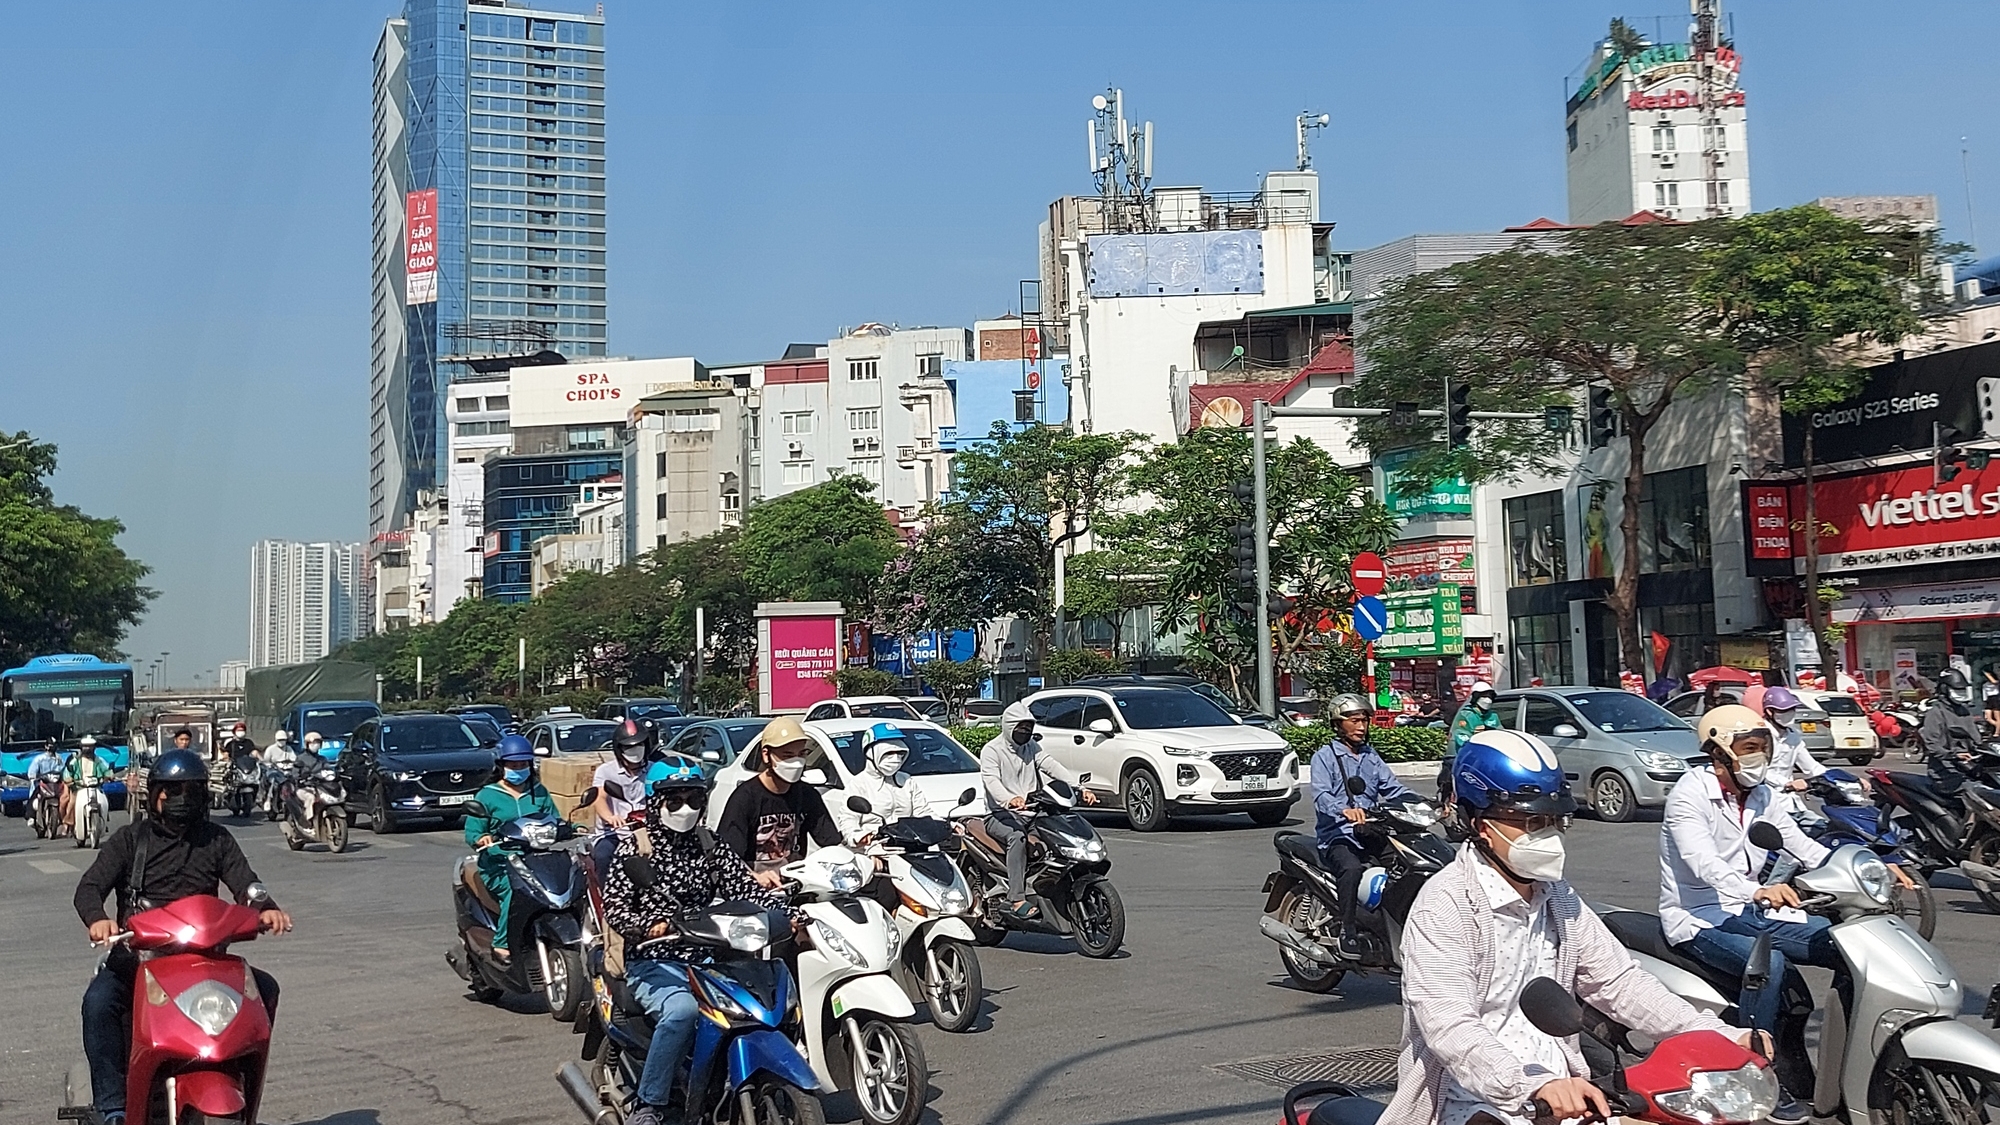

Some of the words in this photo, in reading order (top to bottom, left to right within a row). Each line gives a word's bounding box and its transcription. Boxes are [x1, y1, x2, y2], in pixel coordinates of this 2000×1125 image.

[1628, 89, 1746, 109] RedDrz
[409, 255, 435, 269] GIAO
[577, 373, 610, 385] SPA
[566, 388, 621, 401] CHOI'S
[1812, 406, 1863, 428] Galaxy
[1864, 401, 1889, 419] S23
[1891, 391, 1940, 414] Series
[1757, 492, 1782, 507] BÁN
[1858, 484, 1980, 527] viettel
[1758, 514, 1784, 531] ĐIỆN
[1755, 537, 1789, 551] THOẠI
[1441, 572, 1474, 581] CHERRY
[1440, 586, 1458, 597] TRÁI
[1442, 600, 1457, 611] CÂY
[1919, 596, 1950, 607] Galaxy
[1953, 594, 1968, 604] S23
[1969, 592, 1998, 603] Series
[791, 646, 817, 658] QUẢNG
[818, 646, 834, 657] CÁO
